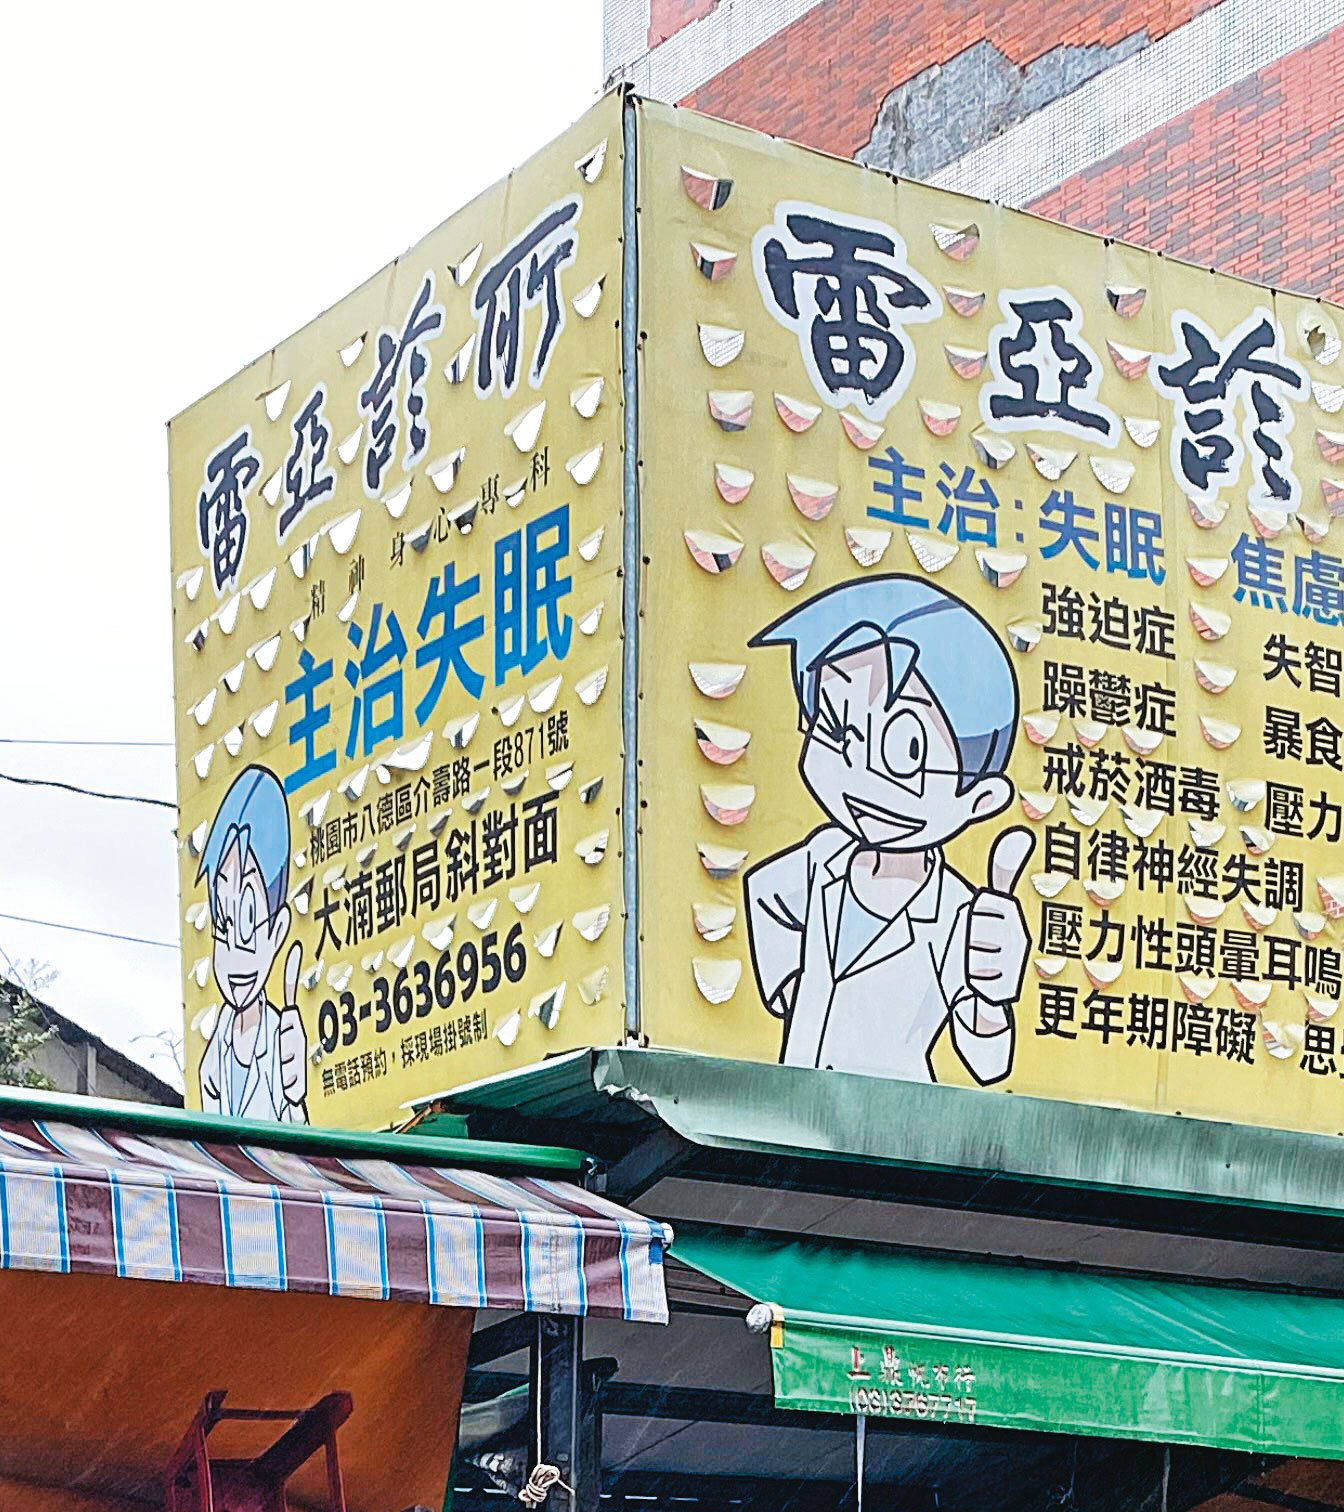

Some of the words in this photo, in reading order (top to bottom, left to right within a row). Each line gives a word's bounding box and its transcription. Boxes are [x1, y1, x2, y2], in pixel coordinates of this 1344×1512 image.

[199, 203, 578, 590] 雷亞診所
[284, 504, 572, 795] 主治失眠
[1042, 583, 1176, 660] 強迫症
[1263, 633, 1342, 698] 失智
[1043, 660, 1177, 738] 躁鬱症
[1263, 706, 1343, 772] 暴食
[310, 710, 570, 867] 桃園市八德區介壽路一段871號
[1043, 742, 1220, 822] 戒菸酒毒
[1265, 780, 1342, 843] 壓力
[314, 790, 560, 960] 大湳郵局斜對面
[1045, 821, 1303, 913] 自律神經失調
[318, 922, 527, 1054] 03-3636956
[1039, 901, 1342, 999] 壓力性頭暈耳鳴
[1035, 983, 1256, 1065] 更年期障礙
